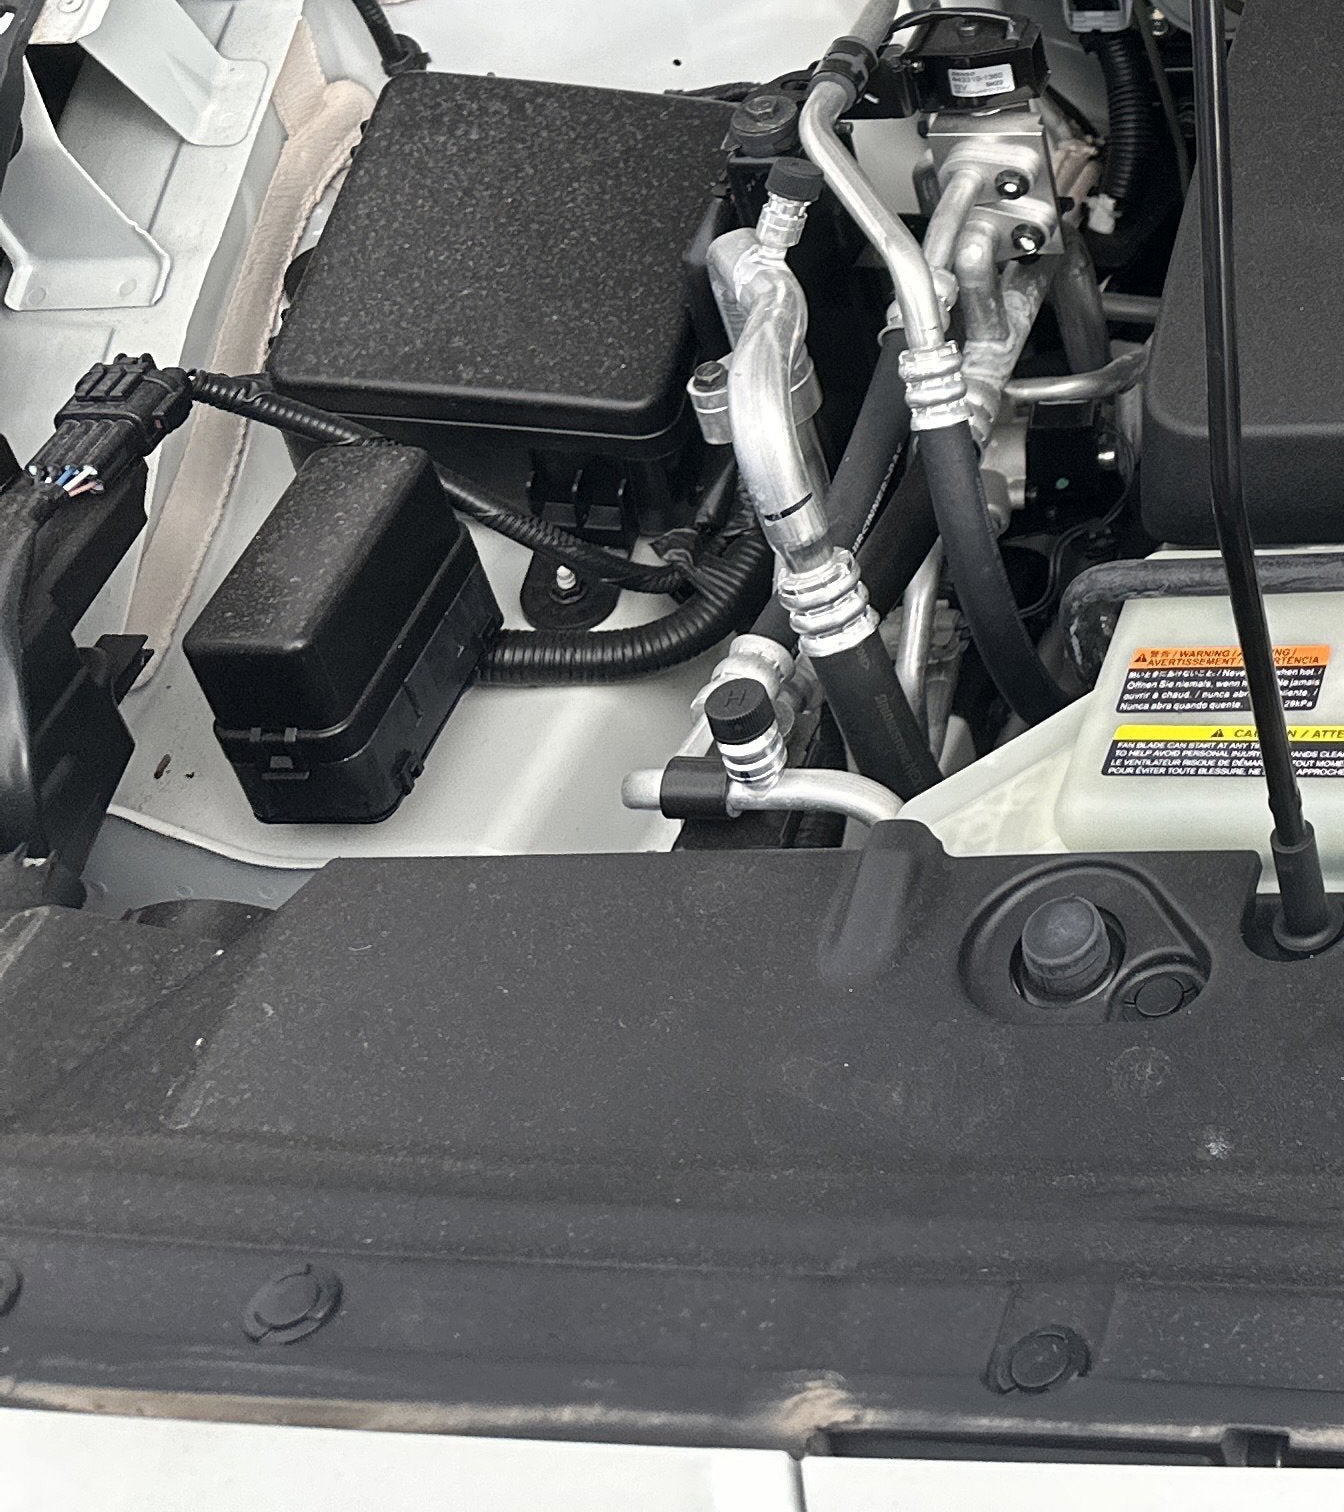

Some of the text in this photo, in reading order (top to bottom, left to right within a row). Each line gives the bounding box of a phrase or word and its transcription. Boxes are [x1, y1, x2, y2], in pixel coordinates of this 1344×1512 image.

[1180, 649, 1230, 658] WARNING
[1147, 657, 1236, 666] AVERTISSEMENT
[1120, 702, 1150, 711] Nunca
[1151, 702, 1172, 710] abra
[1174, 702, 1208, 712] quando
[1115, 750, 1128, 758] TO
[1128, 750, 1154, 758] HELP
[1154, 750, 1181, 758] AVOID
[1182, 750, 1230, 758] PERSONAL
[1124, 758, 1181, 766] VENTILATEUR
[1182, 758, 1216, 766] RISQUE
[1108, 766, 1134, 774] POUR
[1135, 765, 1166, 774] ÉVITER
[1168, 766, 1196, 774] TOUTE
